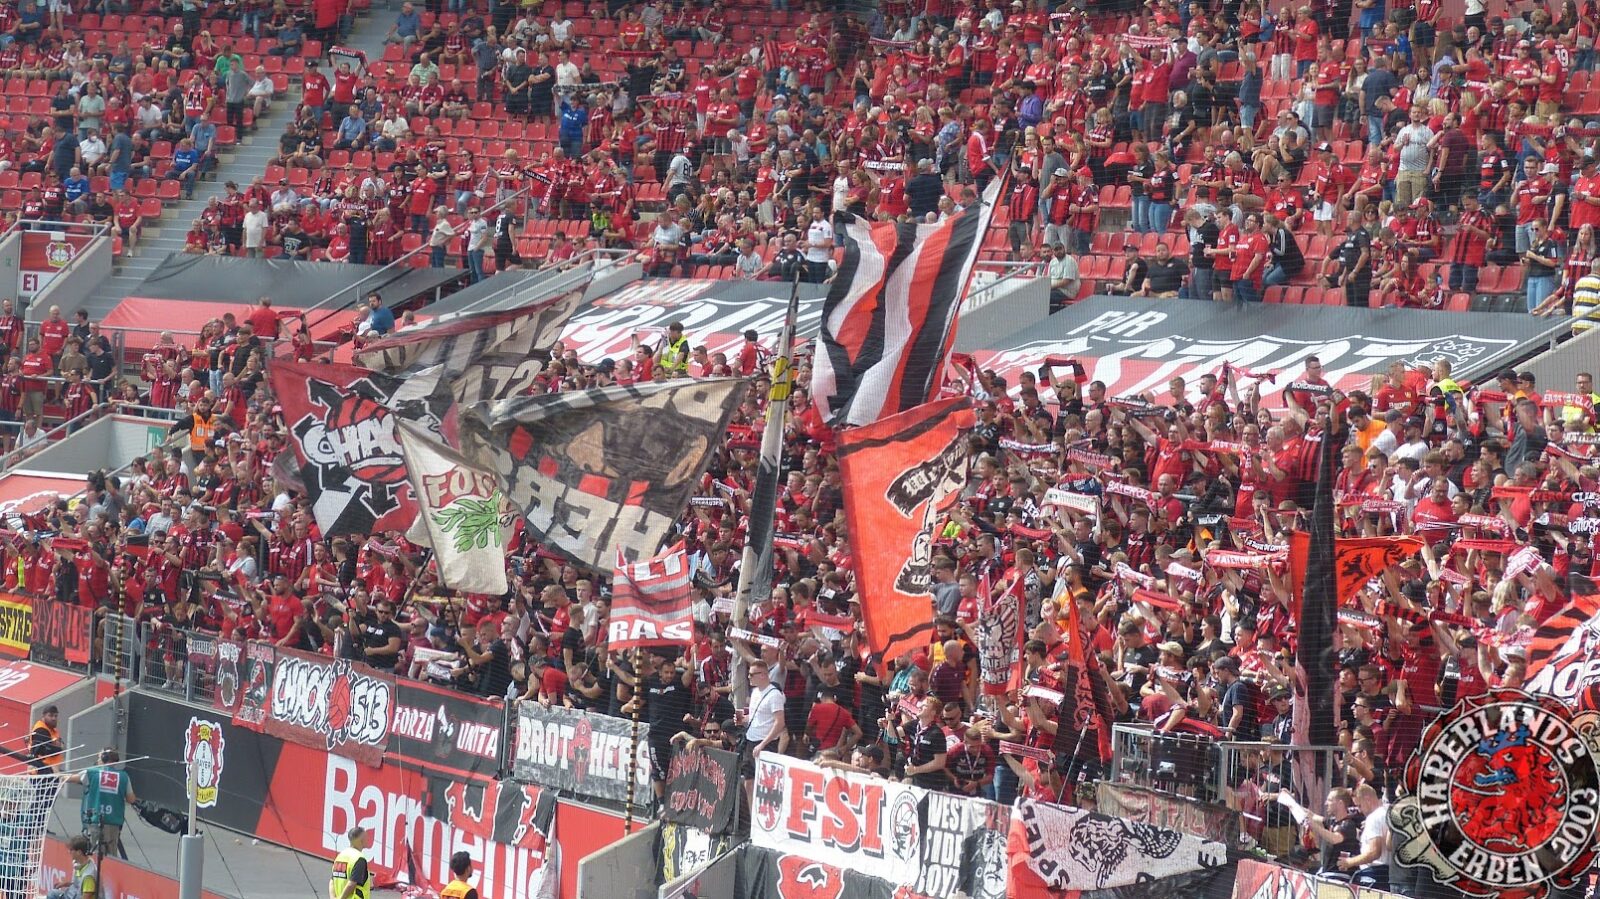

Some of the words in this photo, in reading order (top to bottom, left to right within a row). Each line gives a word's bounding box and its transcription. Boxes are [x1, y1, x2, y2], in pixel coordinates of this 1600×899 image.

[23, 273, 39, 291] E1
[609, 619, 692, 643] RAS
[392, 706, 436, 743] FORZA
